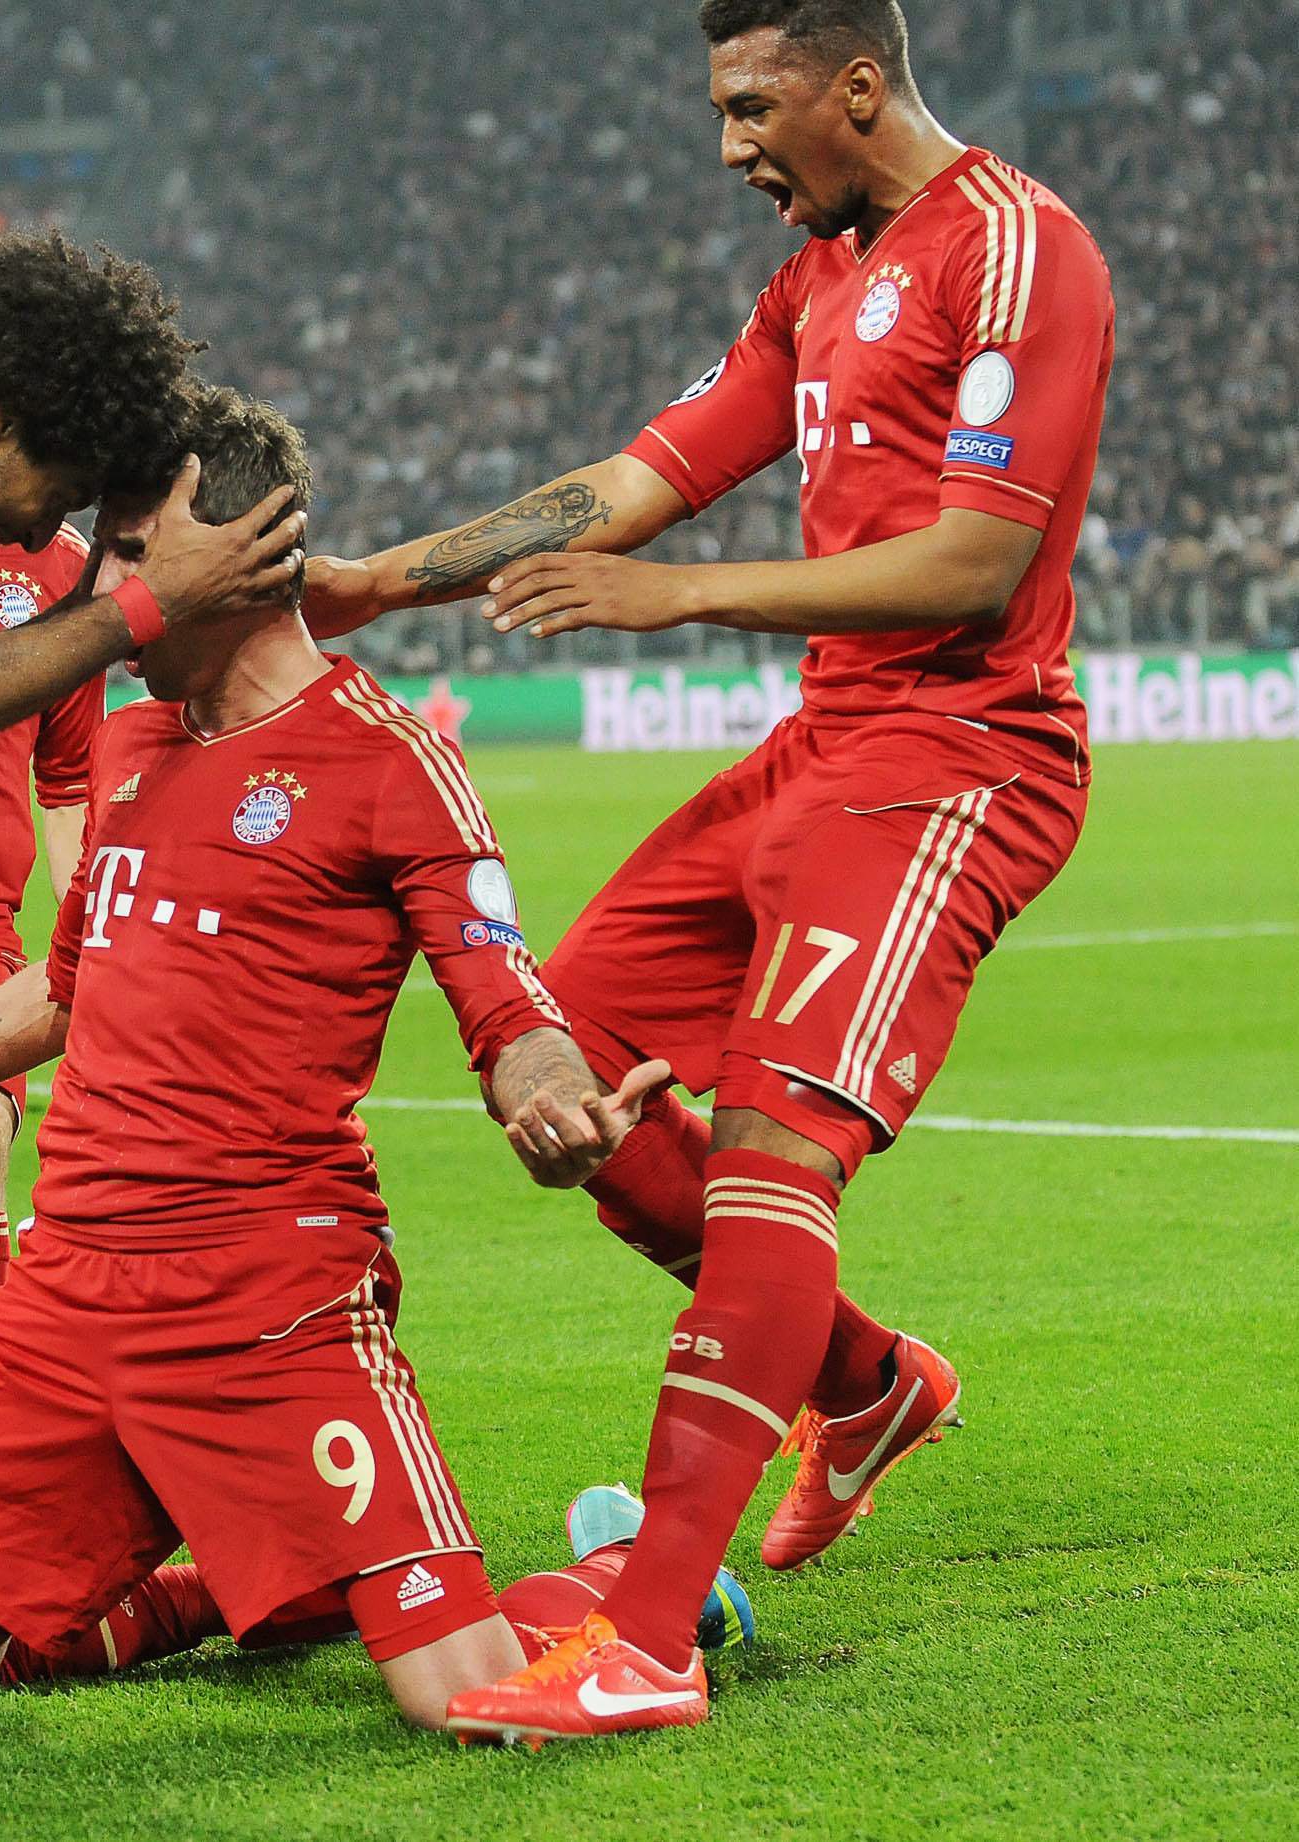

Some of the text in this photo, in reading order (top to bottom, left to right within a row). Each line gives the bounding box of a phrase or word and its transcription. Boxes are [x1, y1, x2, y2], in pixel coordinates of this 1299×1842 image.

[949, 438, 1012, 461] RESPECT
[581, 662, 806, 753] Heinek
[1085, 648, 1299, 745] Heine
[258, 789, 289, 820] BAYERN
[83, 845, 147, 949] T
[750, 922, 860, 1025] 17
[312, 1419, 376, 1525] 9
[396, 1576, 443, 1600] adidas
